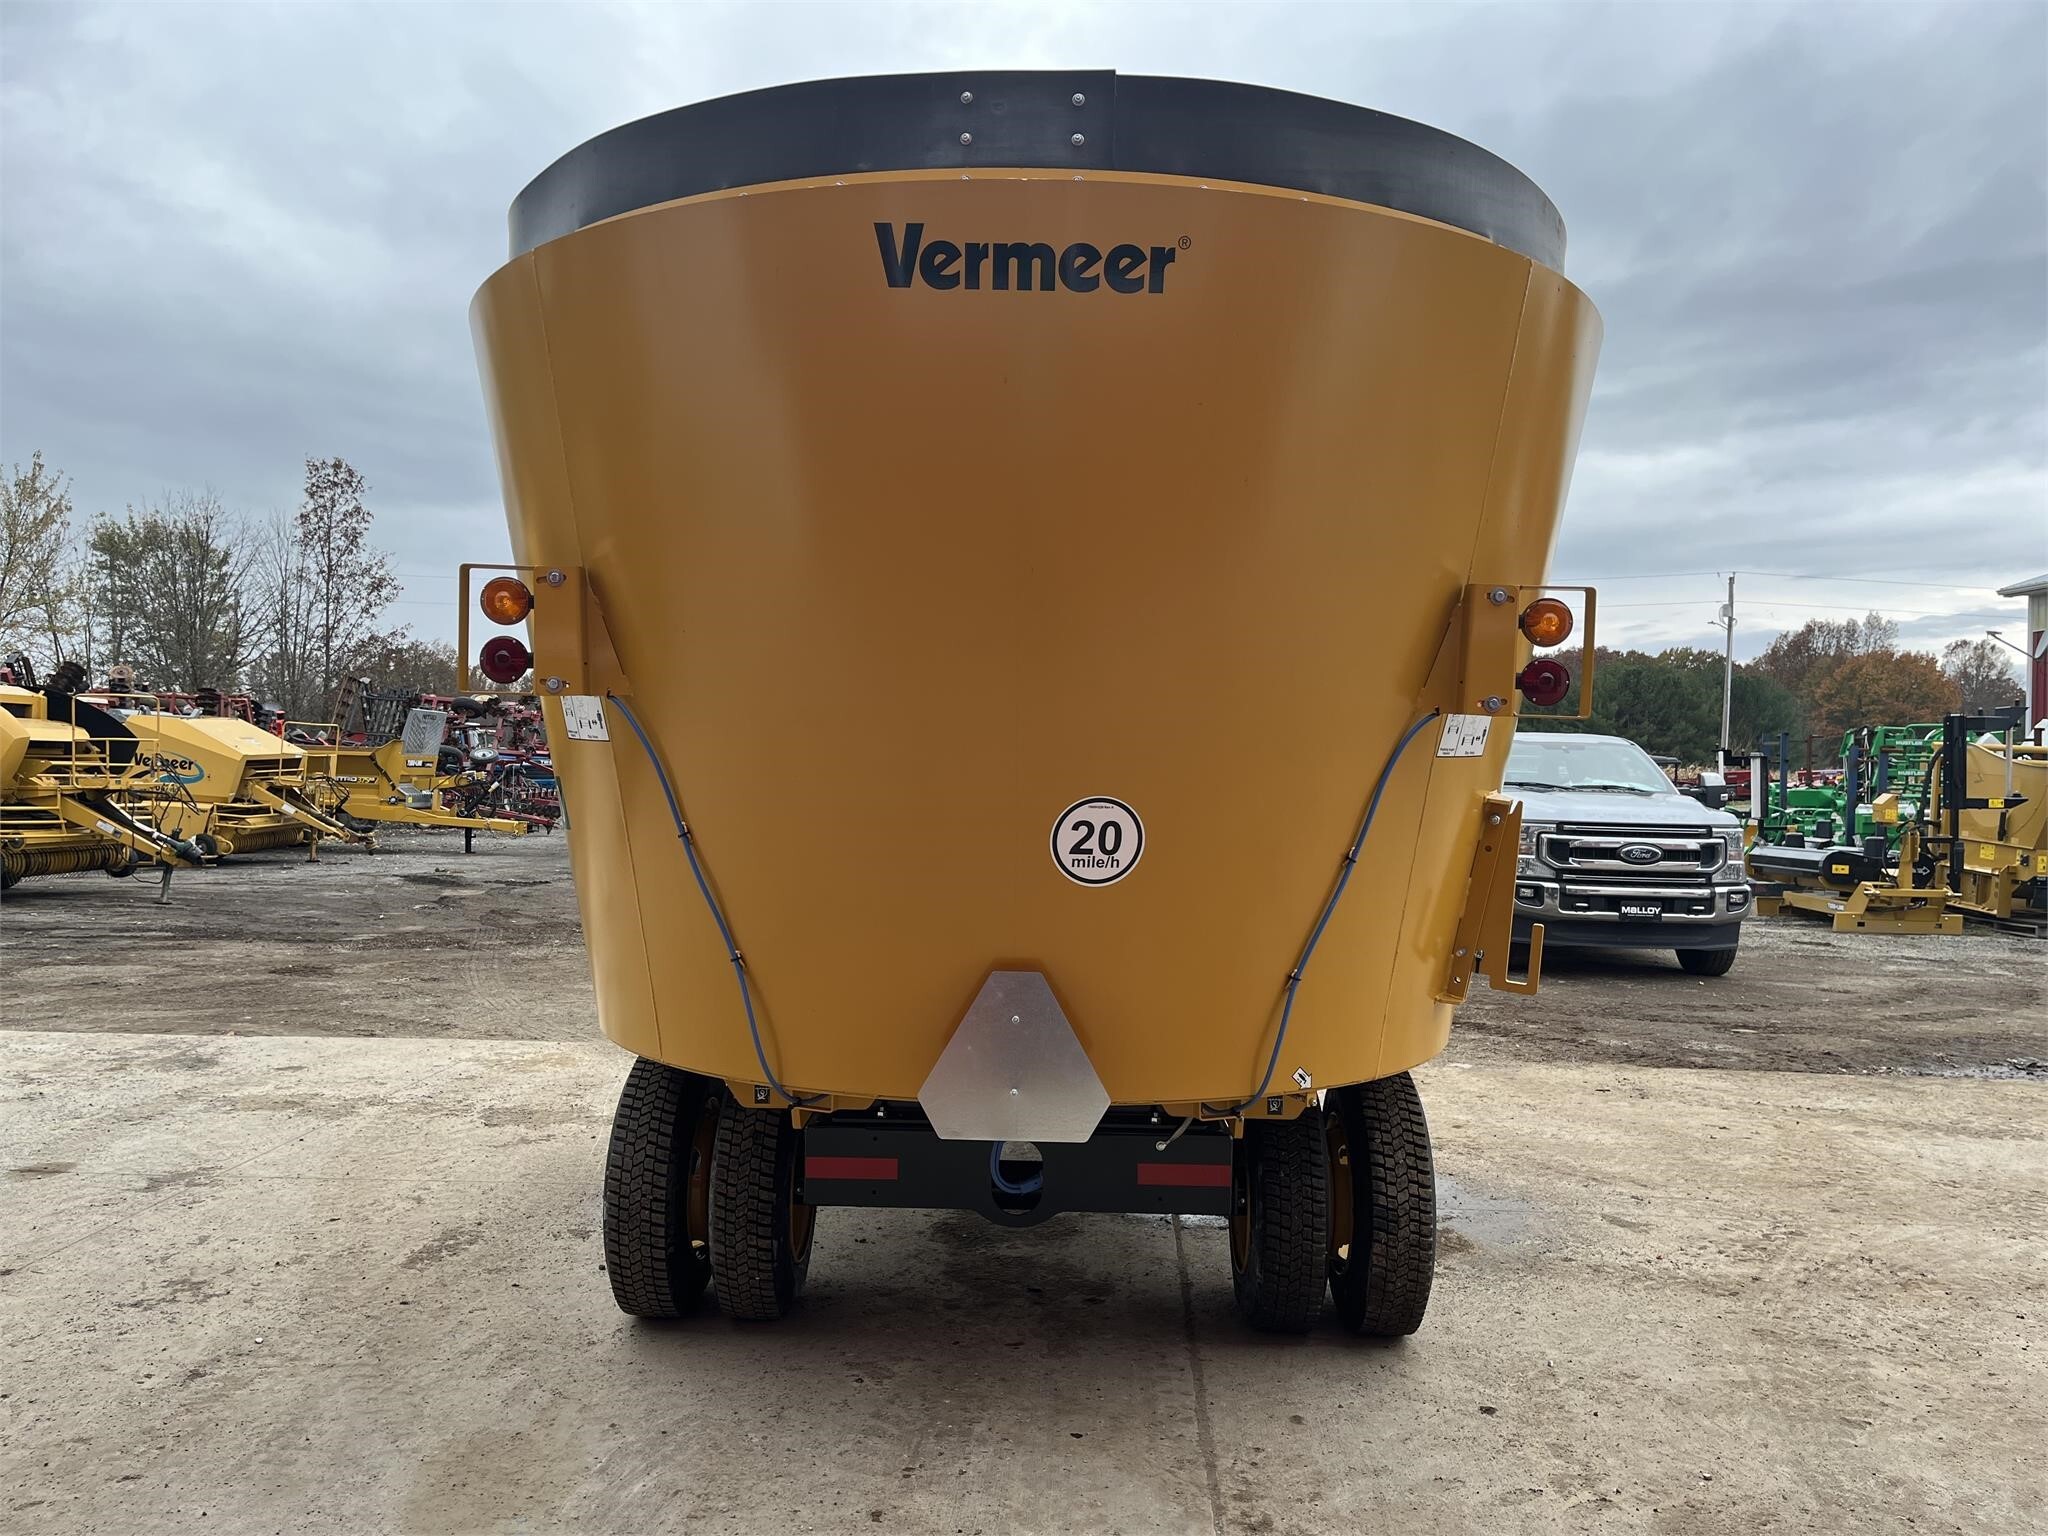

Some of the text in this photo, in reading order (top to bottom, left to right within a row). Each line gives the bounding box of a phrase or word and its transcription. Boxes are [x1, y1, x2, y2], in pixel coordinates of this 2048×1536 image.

[1069, 820, 1122, 855] 20
[1630, 848, 1652, 859] Ford
[1072, 856, 1120, 868] mile/h
